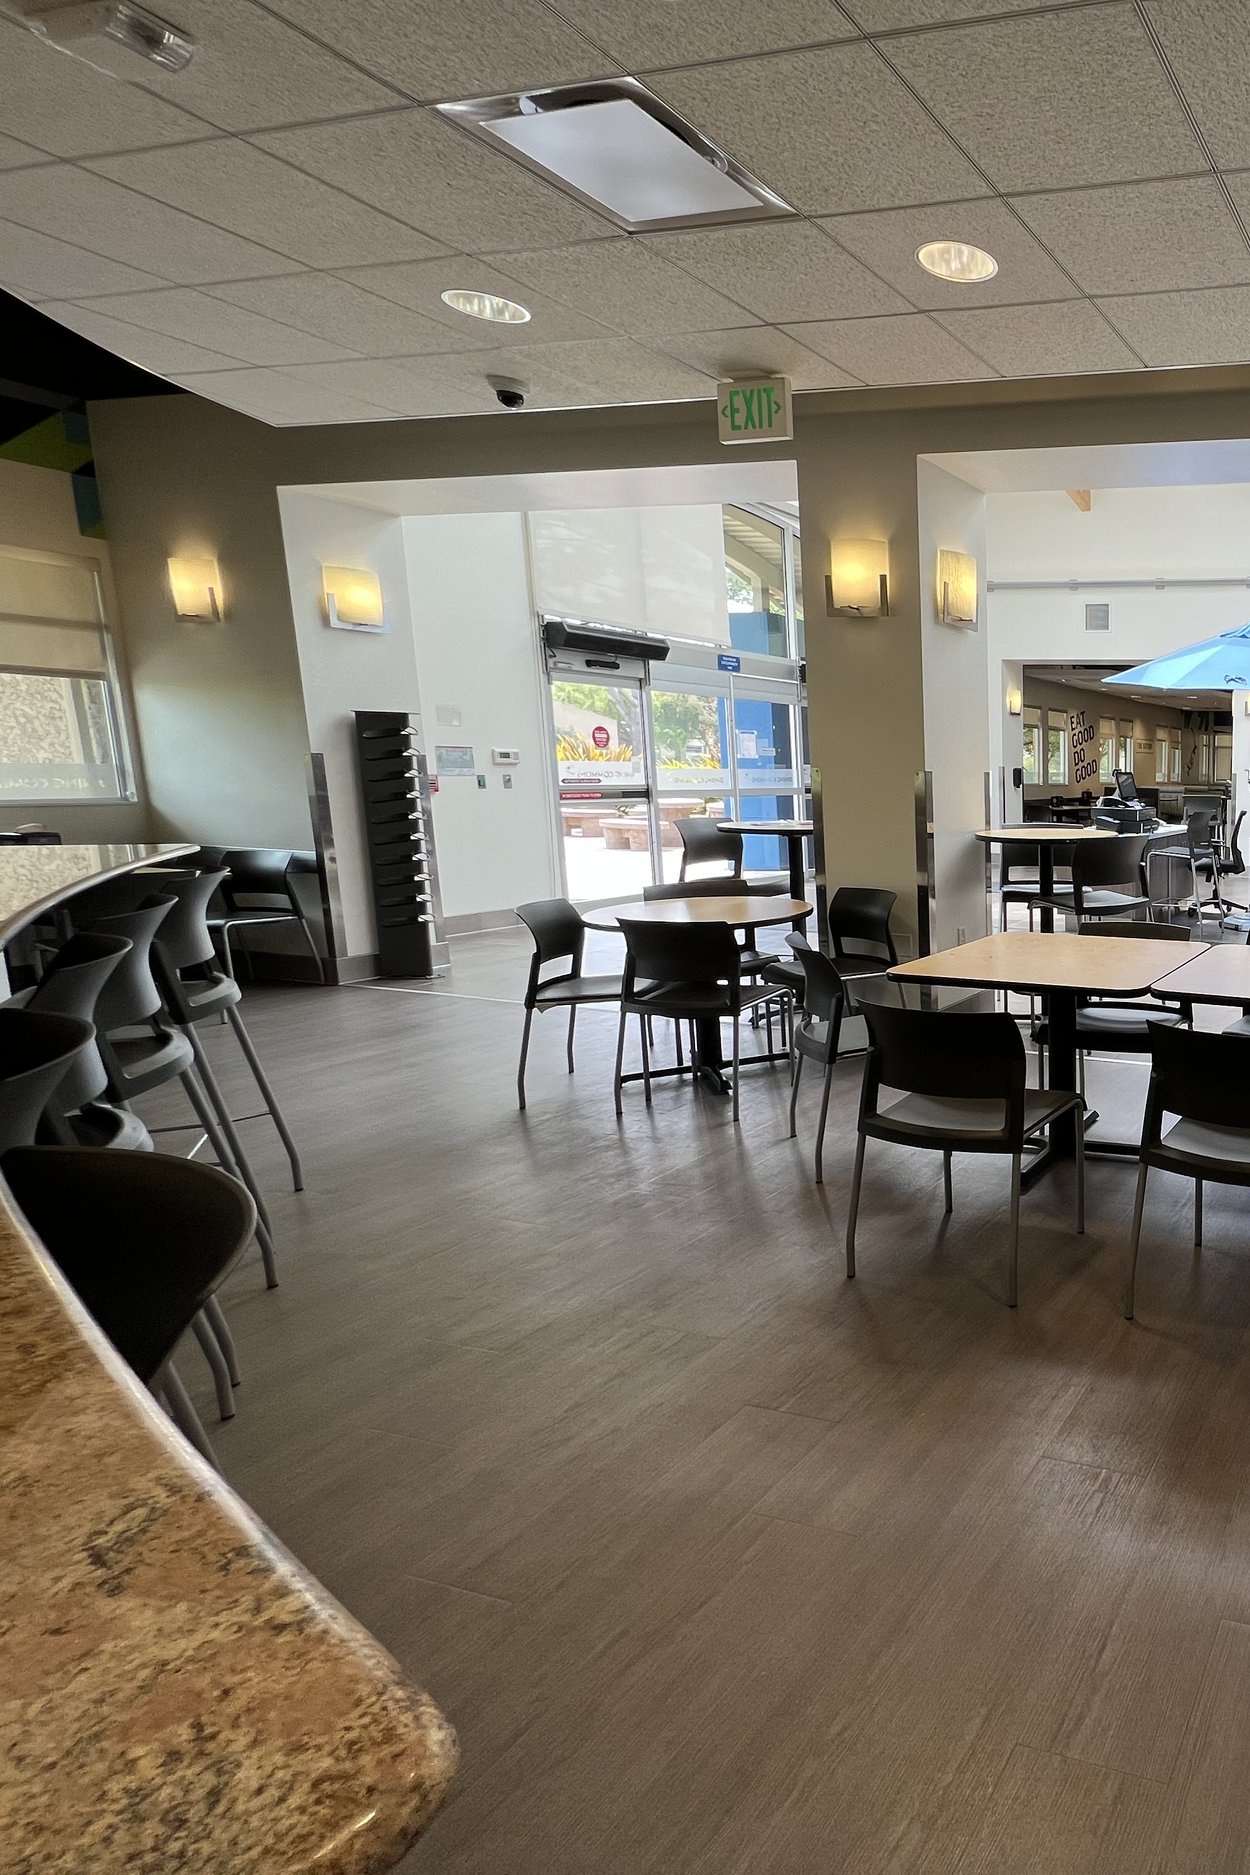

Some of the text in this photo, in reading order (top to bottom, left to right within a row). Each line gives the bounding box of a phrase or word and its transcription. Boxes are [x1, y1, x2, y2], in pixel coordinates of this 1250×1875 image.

[729, 387, 775, 431] EXIT
[1070, 711, 1085, 731] EAT
[1072, 725, 1094, 748] GOOD
[1074, 748, 1085, 766] DO
[1075, 759, 1097, 784] GOOD
